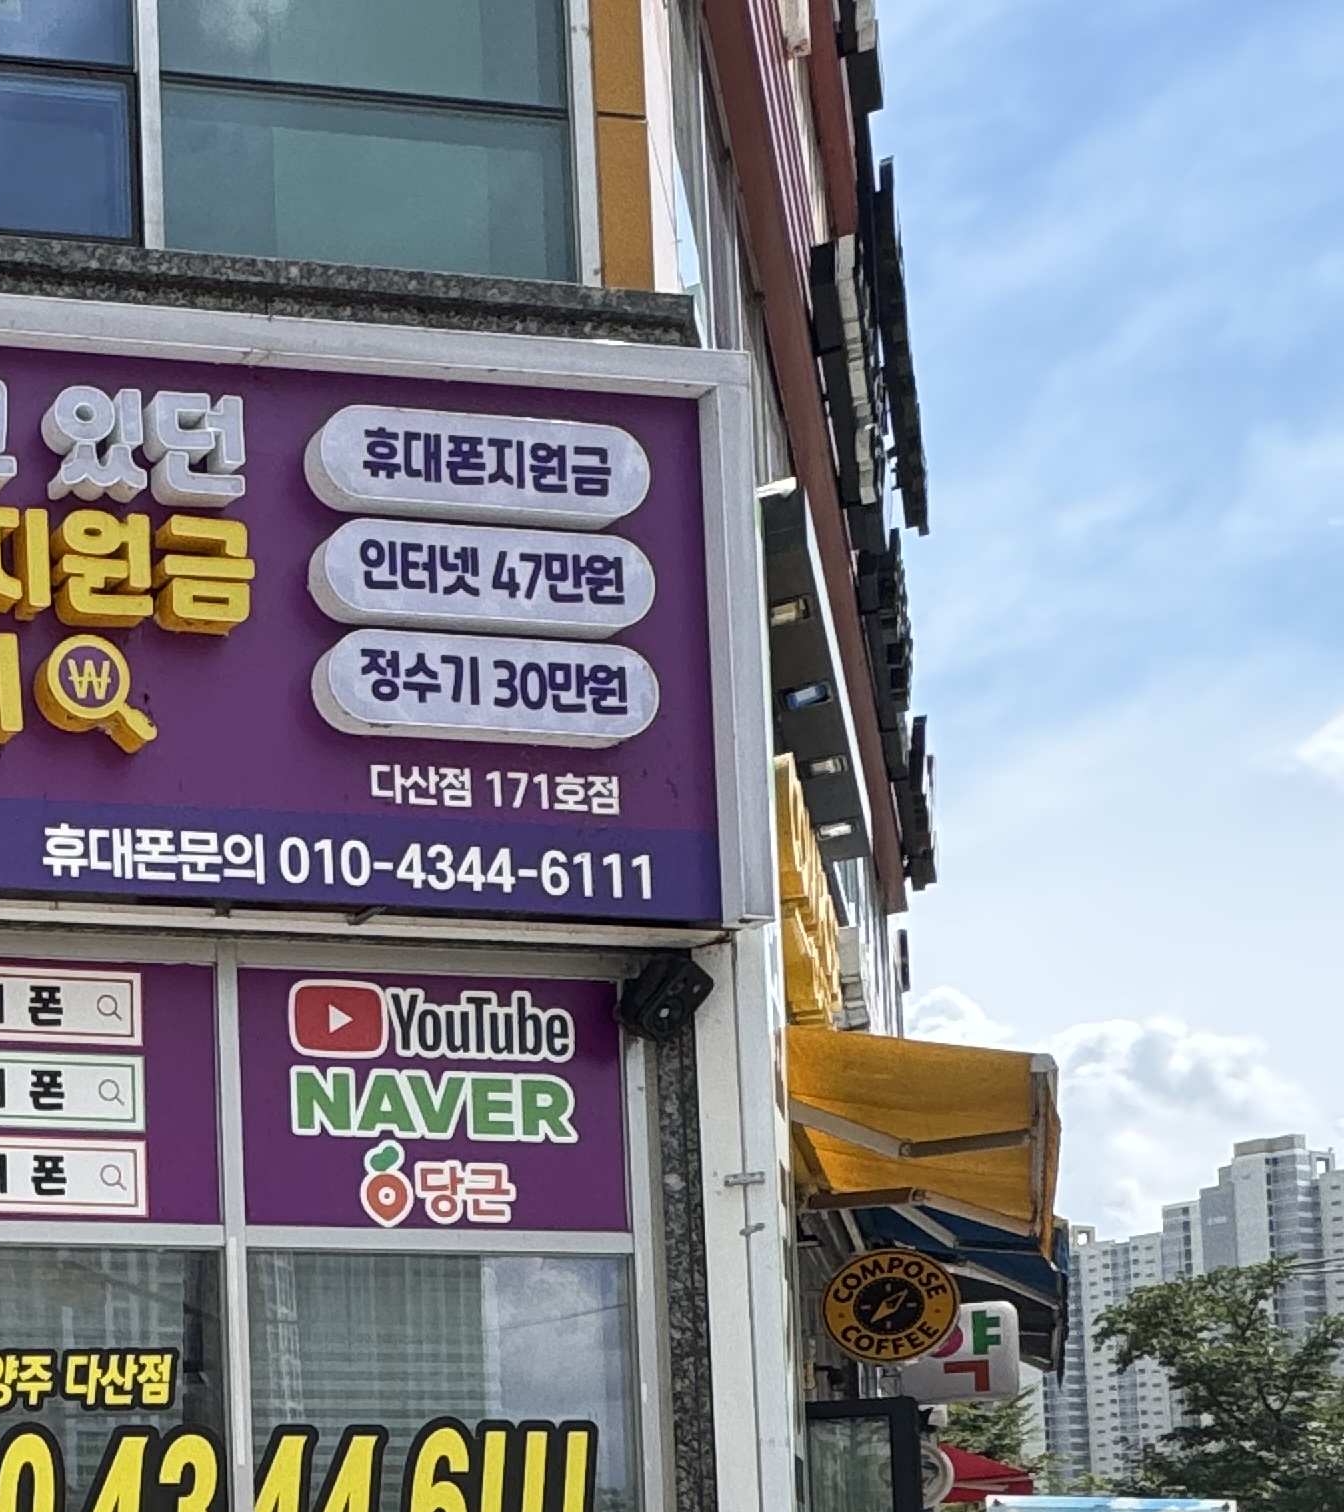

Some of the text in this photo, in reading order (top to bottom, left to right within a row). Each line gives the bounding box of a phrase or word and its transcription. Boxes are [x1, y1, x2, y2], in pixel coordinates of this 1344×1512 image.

[42, 385, 246, 508] 있던
[362, 425, 612, 498] 휴대폰지원금
[358, 538, 625, 605] 인터넷 47만원
[359, 646, 629, 714] 정수기 30만원
[370, 764, 620, 814] 다산점 171호점
[42, 822, 653, 900] 휴대폰문의 010-4344-6111
[391, 993, 569, 1056] YouTube
[295, 1071, 572, 1138] NAVER
[420, 1167, 512, 1218] 당근
[833, 1257, 947, 1303] COMPOSE
[841, 1321, 939, 1355] COFFEE
[65, 1354, 173, 1406] 다산점
